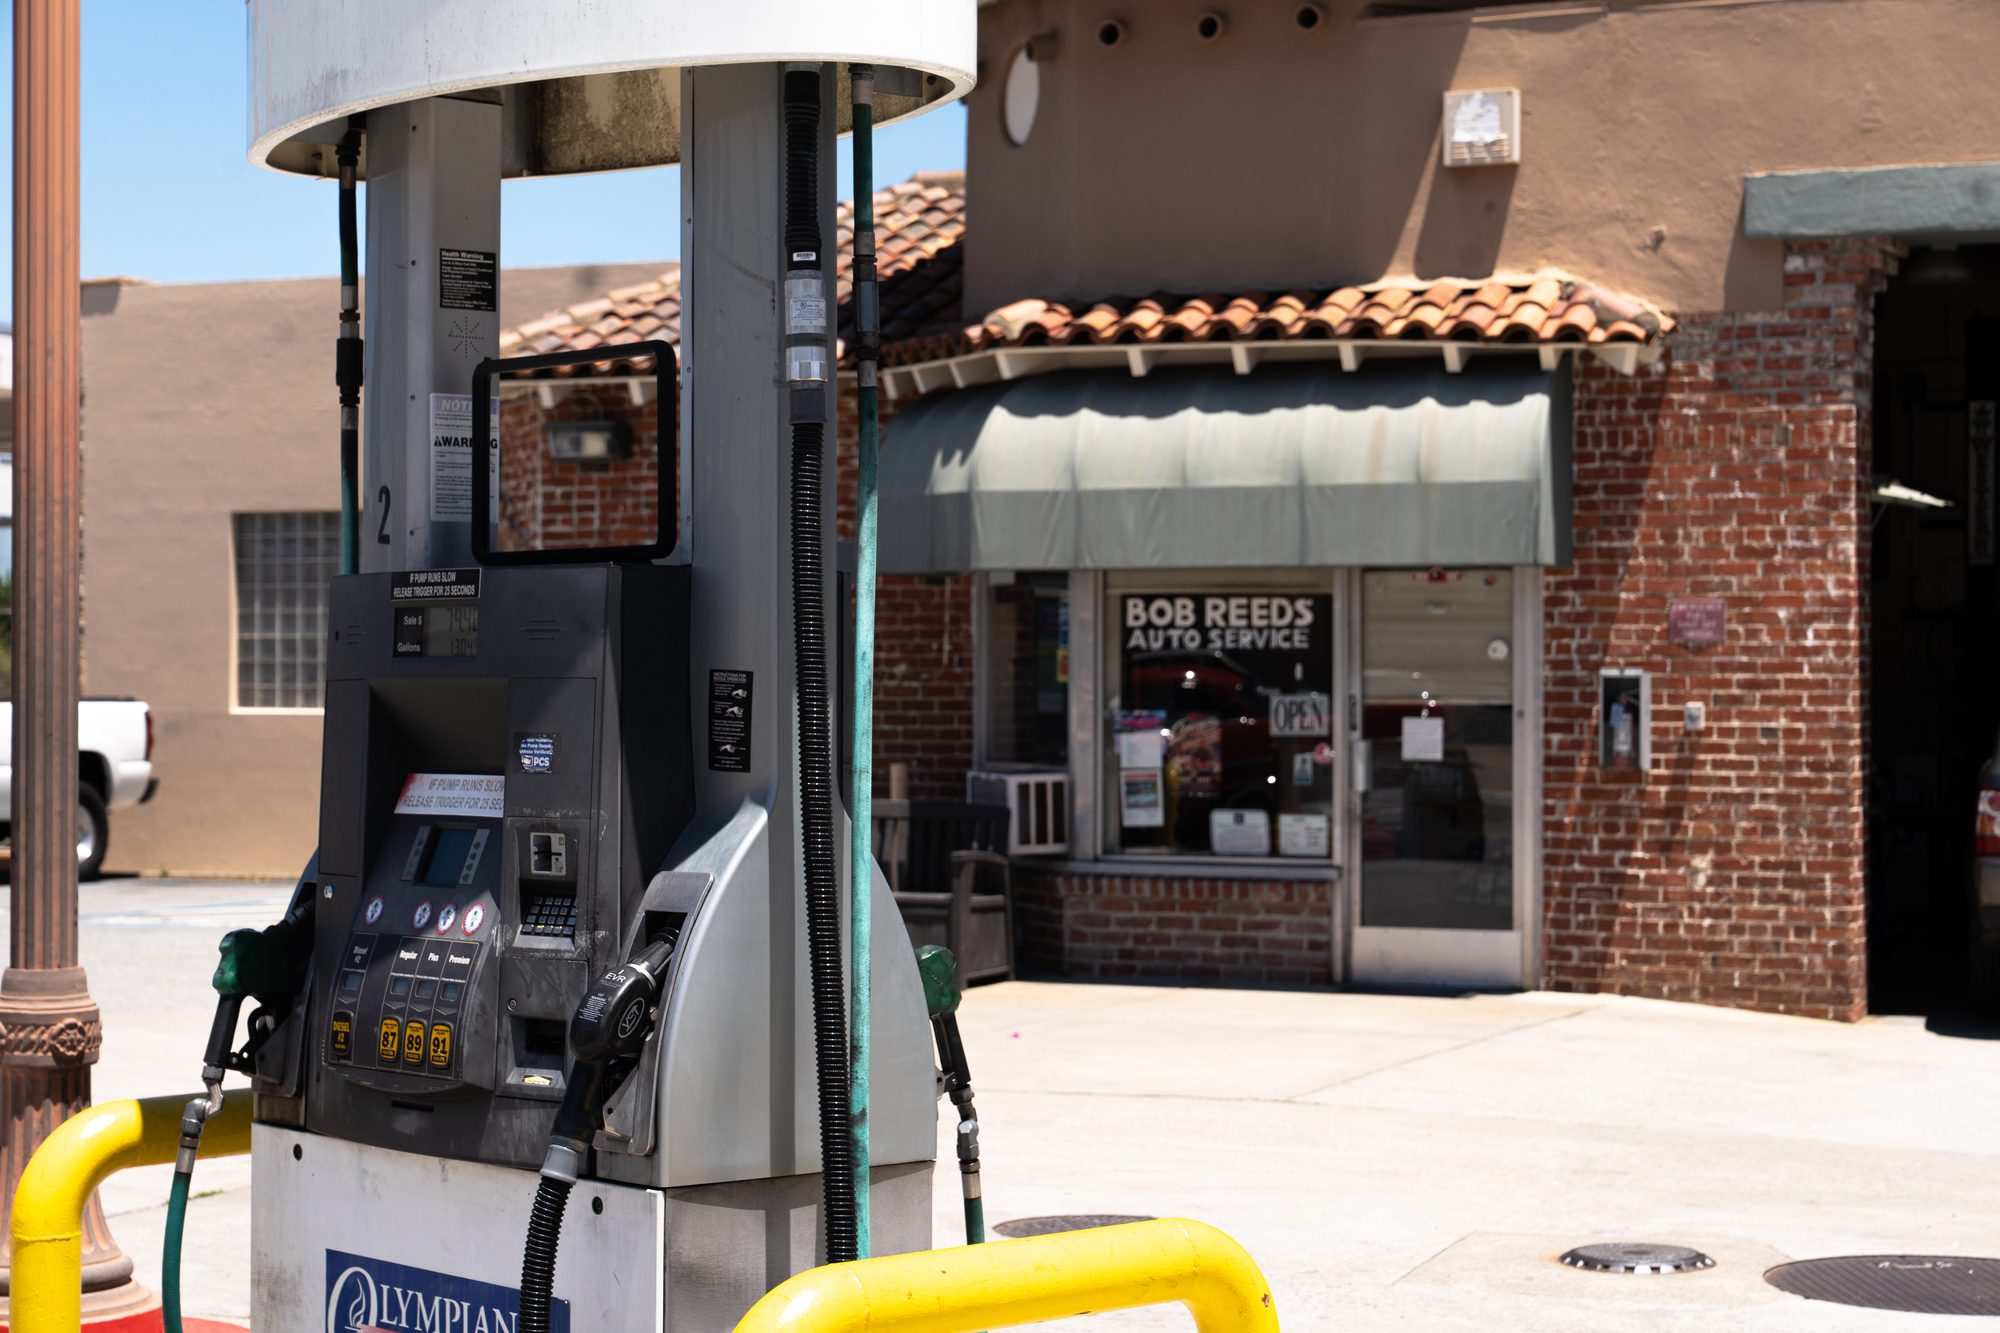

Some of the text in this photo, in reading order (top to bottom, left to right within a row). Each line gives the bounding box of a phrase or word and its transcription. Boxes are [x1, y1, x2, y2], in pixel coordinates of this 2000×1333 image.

[441, 250, 484, 261] Health Warning
[441, 437, 498, 449] WARG
[378, 485, 391, 545] 2
[410, 571, 457, 584] IF PUMP RUNS SLOW
[393, 584, 476, 598] RELEASE TRIGGER FOR 25 SECONDS
[1126, 597, 1315, 628] BOB REEDS
[403, 615, 423, 627] Sale $
[1127, 628, 1311, 651] AUTO SERVICE
[397, 642, 420, 653] Gallons
[1273, 699, 1325, 731] OPEN
[533, 756, 550, 767] PCS
[428, 778, 438, 791] IF
[438, 778, 461, 792] PUMP
[461, 778, 484, 792] RUNS
[402, 795, 432, 808] RELEASE
[434, 795, 465, 809] TRIGGER
[464, 797, 481, 810] FOR
[480, 798, 491, 810] 25
[353, 945, 369, 956] Diesel
[399, 949, 418, 961] Regular
[428, 952, 440, 962] Plus
[449, 954, 471, 965] Premium
[605, 972, 627, 983] EVR
[622, 1005, 639, 1031] VST
[332, 1020, 350, 1032] DIESEL
[382, 1031, 398, 1049] 87
[407, 1034, 422, 1052] 89
[432, 1037, 449, 1055] 91
[328, 1266, 519, 1333] OLYMPIAN
